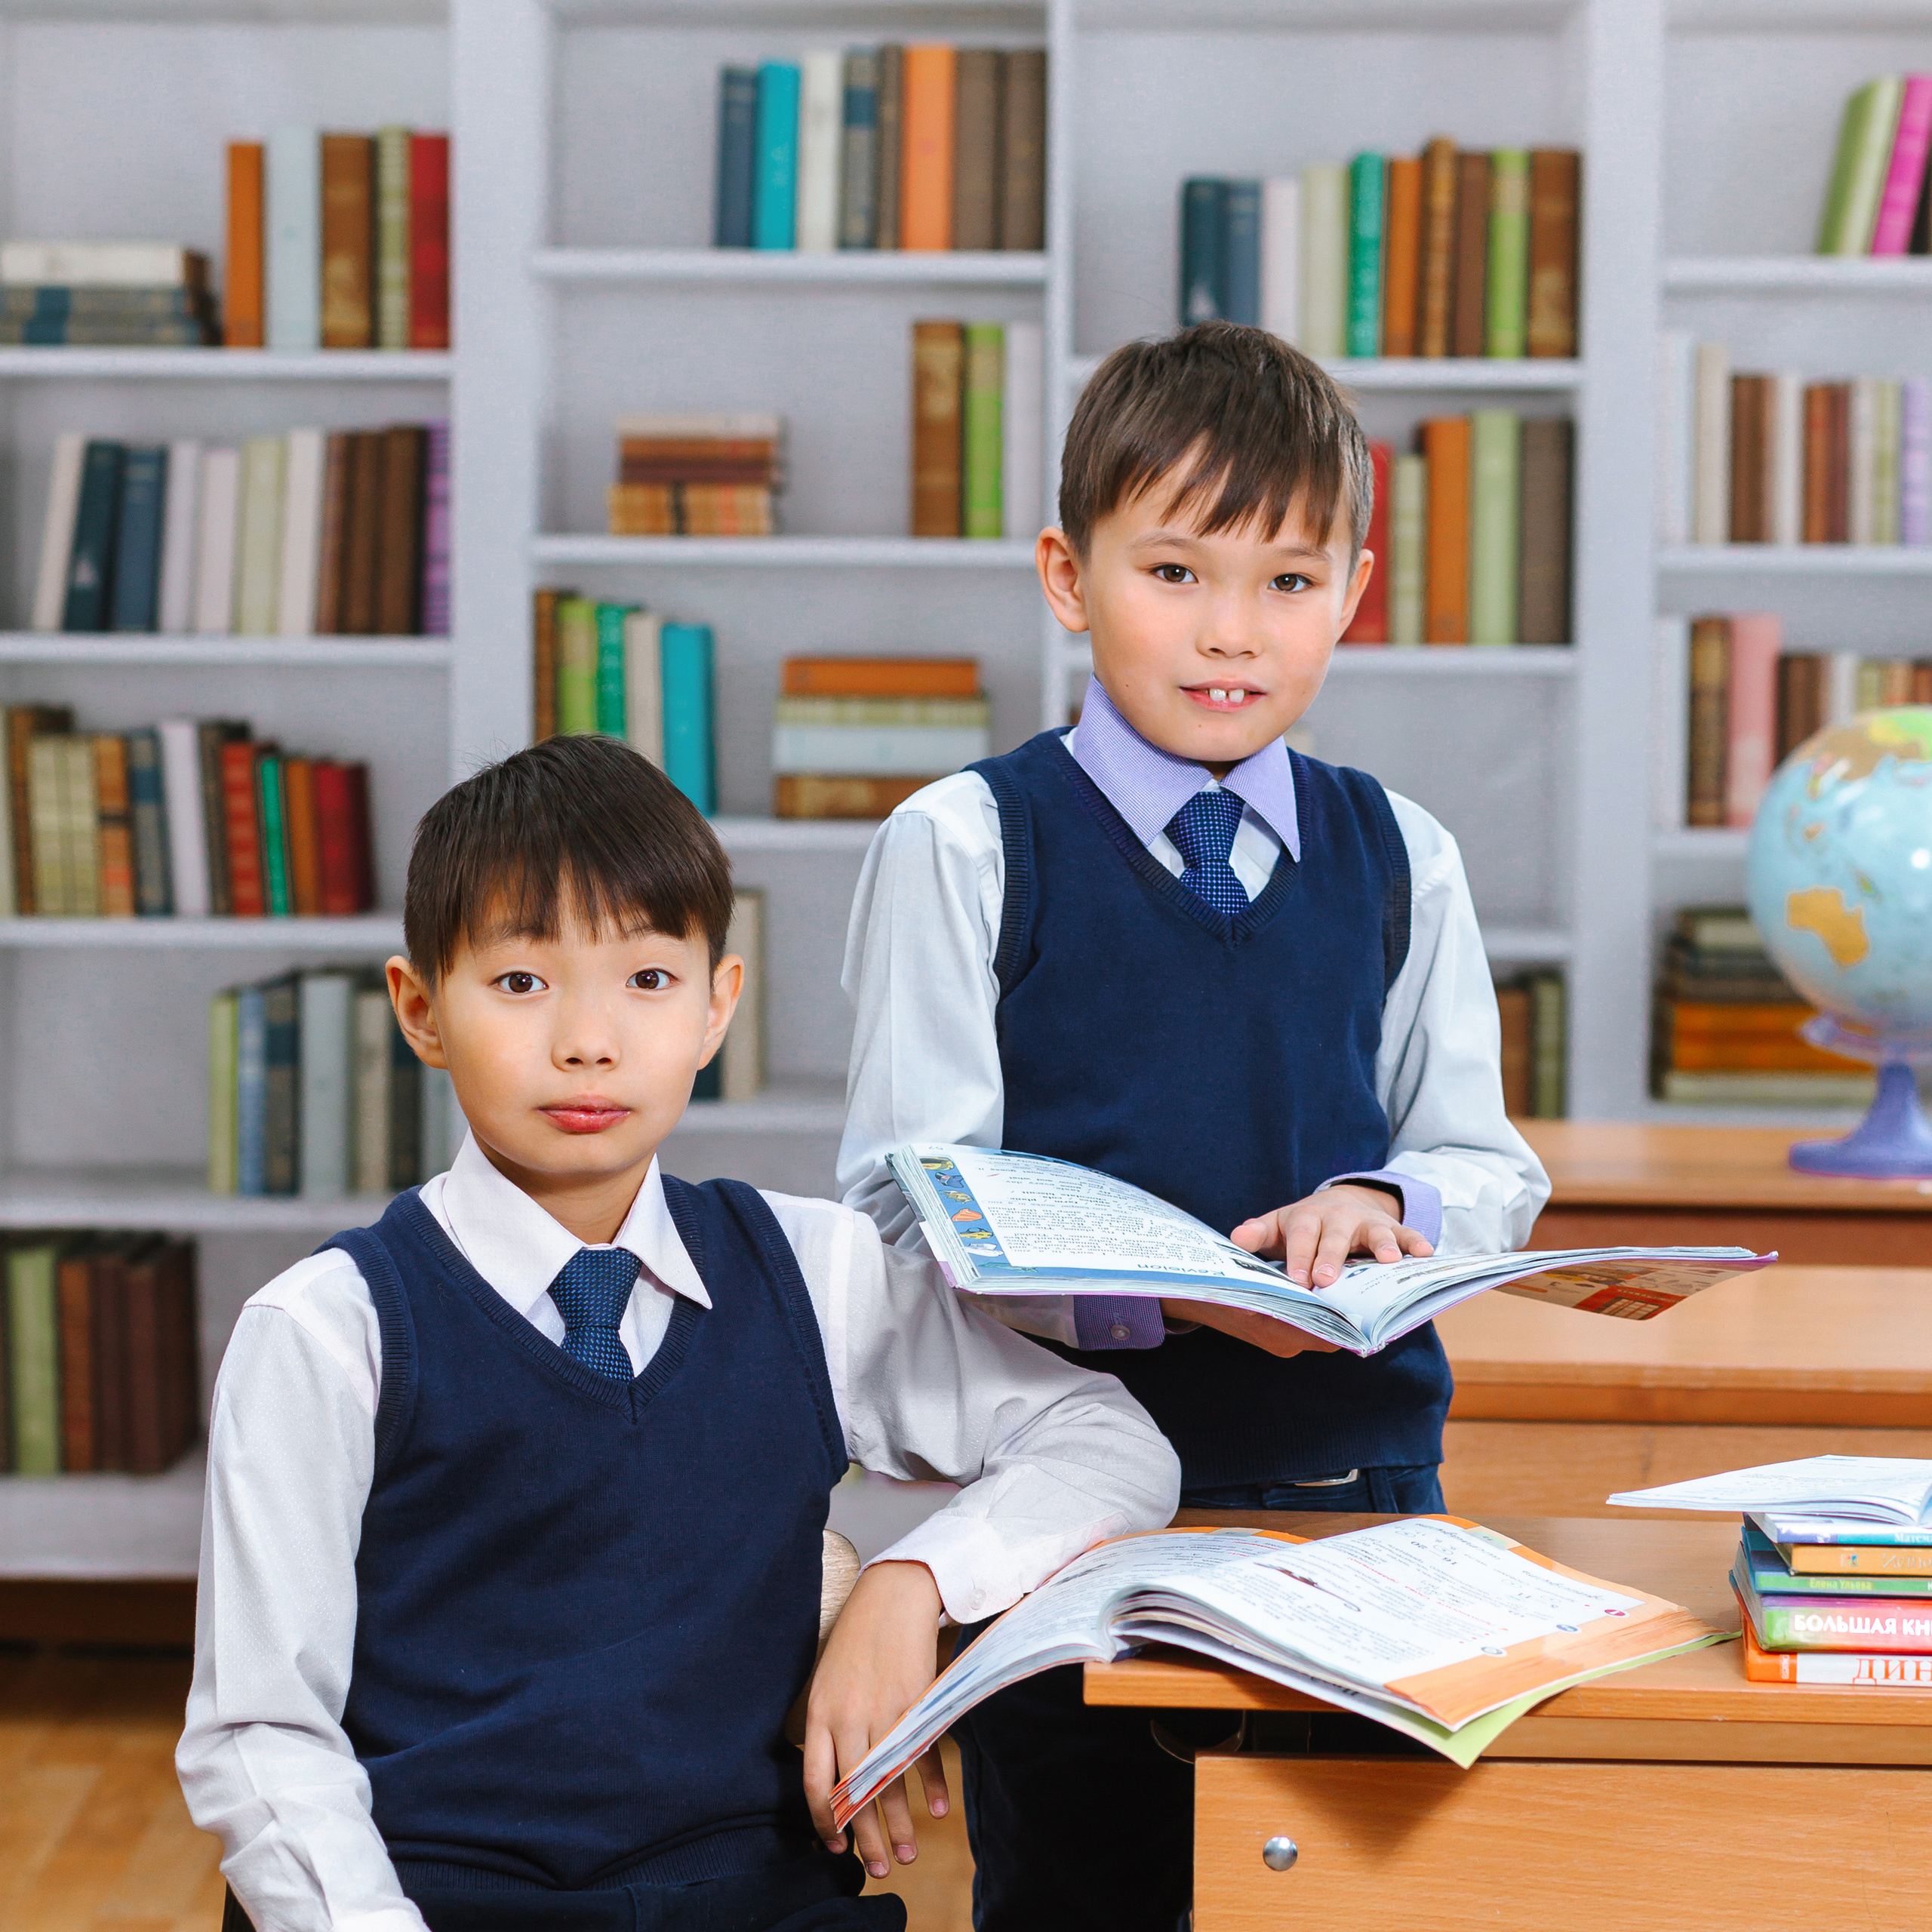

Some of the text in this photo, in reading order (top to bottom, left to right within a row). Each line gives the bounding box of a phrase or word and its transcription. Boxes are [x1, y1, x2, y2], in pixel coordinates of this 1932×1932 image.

[1137, 1263, 1226, 1276] Revision
[1794, 1614, 1932, 1636] БОЛЬШАЯ КН
